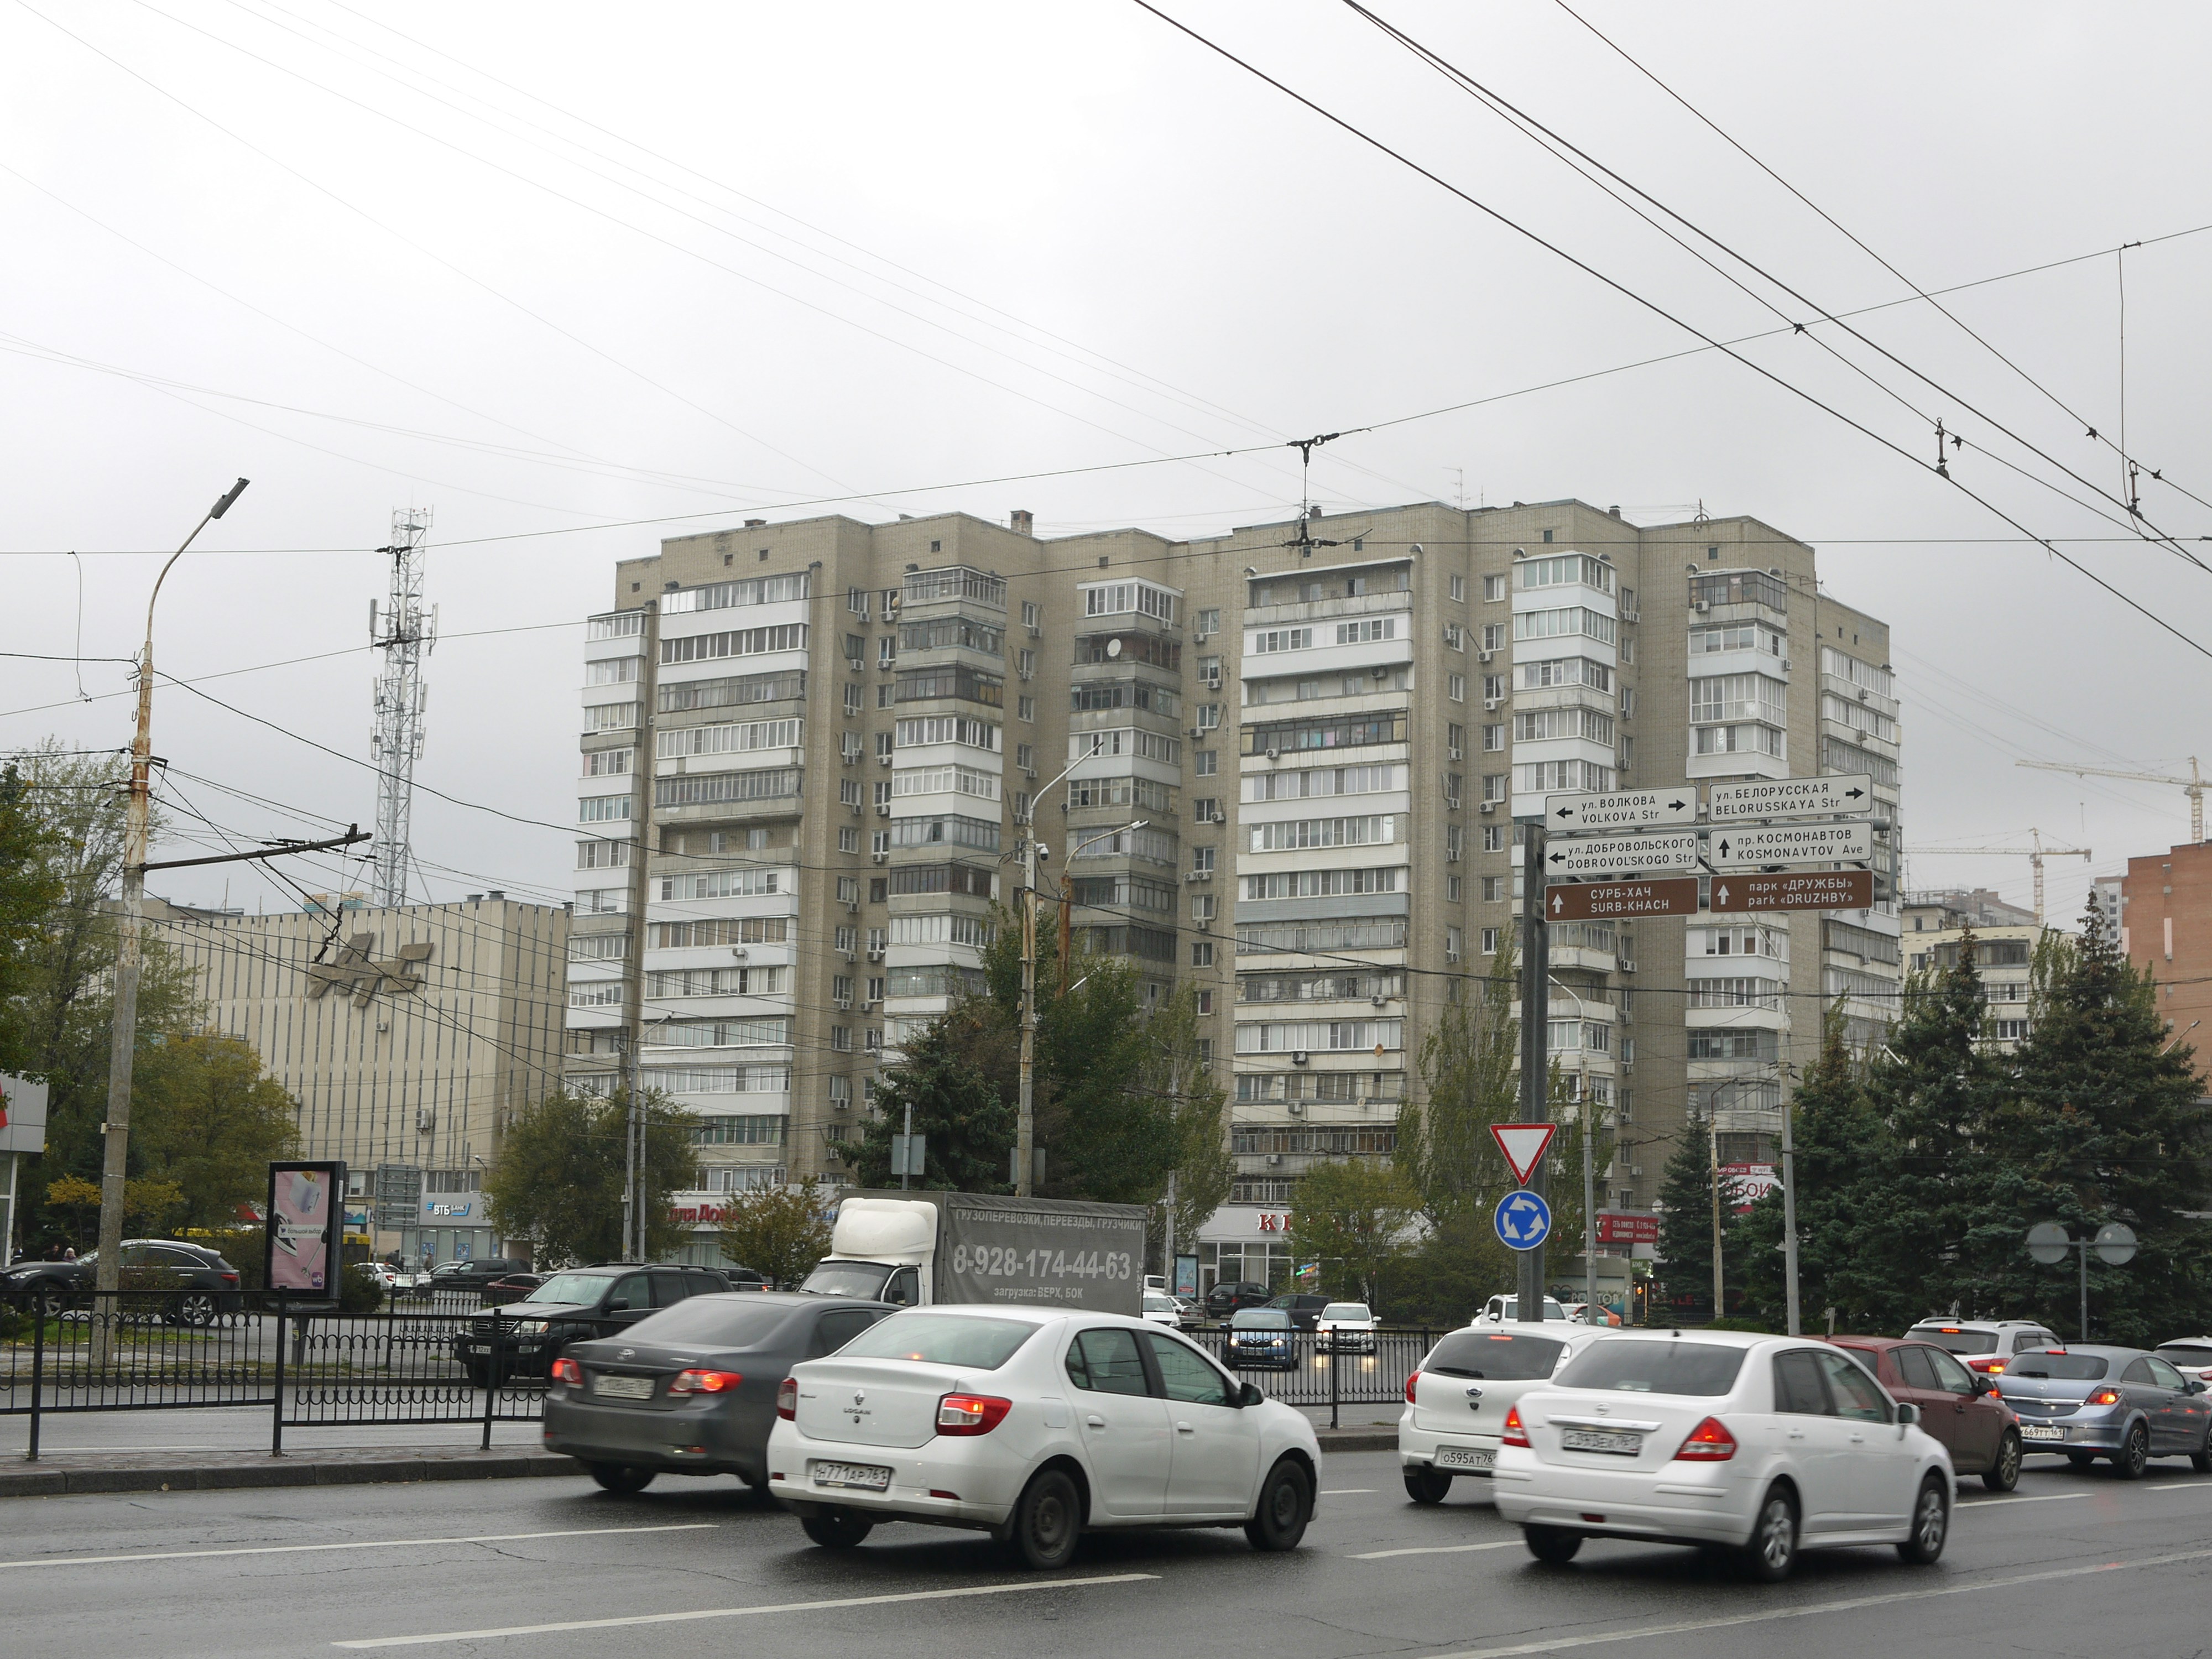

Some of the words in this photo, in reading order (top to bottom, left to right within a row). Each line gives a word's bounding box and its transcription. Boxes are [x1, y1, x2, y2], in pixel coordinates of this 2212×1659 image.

[1716, 800, 1815, 815] BELORUSSKAYA
[1822, 798, 1840, 808] Str
[1582, 811, 1636, 823] VOLKOVA
[1642, 810, 1660, 820] Str
[1676, 853, 1693, 863] Str
[1738, 845, 1834, 860] KOSMONAVTOV
[1843, 844, 1864, 854] Ave
[1590, 886, 1651, 900] СУРБ-ХАЧ
[1749, 883, 1778, 894] парк
[1782, 878, 1853, 891] «ДРУЖБЫ»
[1590, 899, 1669, 913] SURB-KHACH
[1748, 895, 1776, 908] park
[1780, 891, 1853, 905] «DRUZHBY»
[434, 1204, 450, 1215] ВТБ
[1097, 1218, 1141, 1230] ГРУЗЧИКИ
[953, 1244, 1131, 1280] 8-928-174-44-63
[312, 1275, 322, 1283] wb
[994, 1287, 1037, 1300] загрузка:
[1037, 1286, 1063, 1300] ВЕРХ,
[1065, 1287, 1084, 1298] БОК
[1571, 1292, 1620, 1305] РОТОВ
